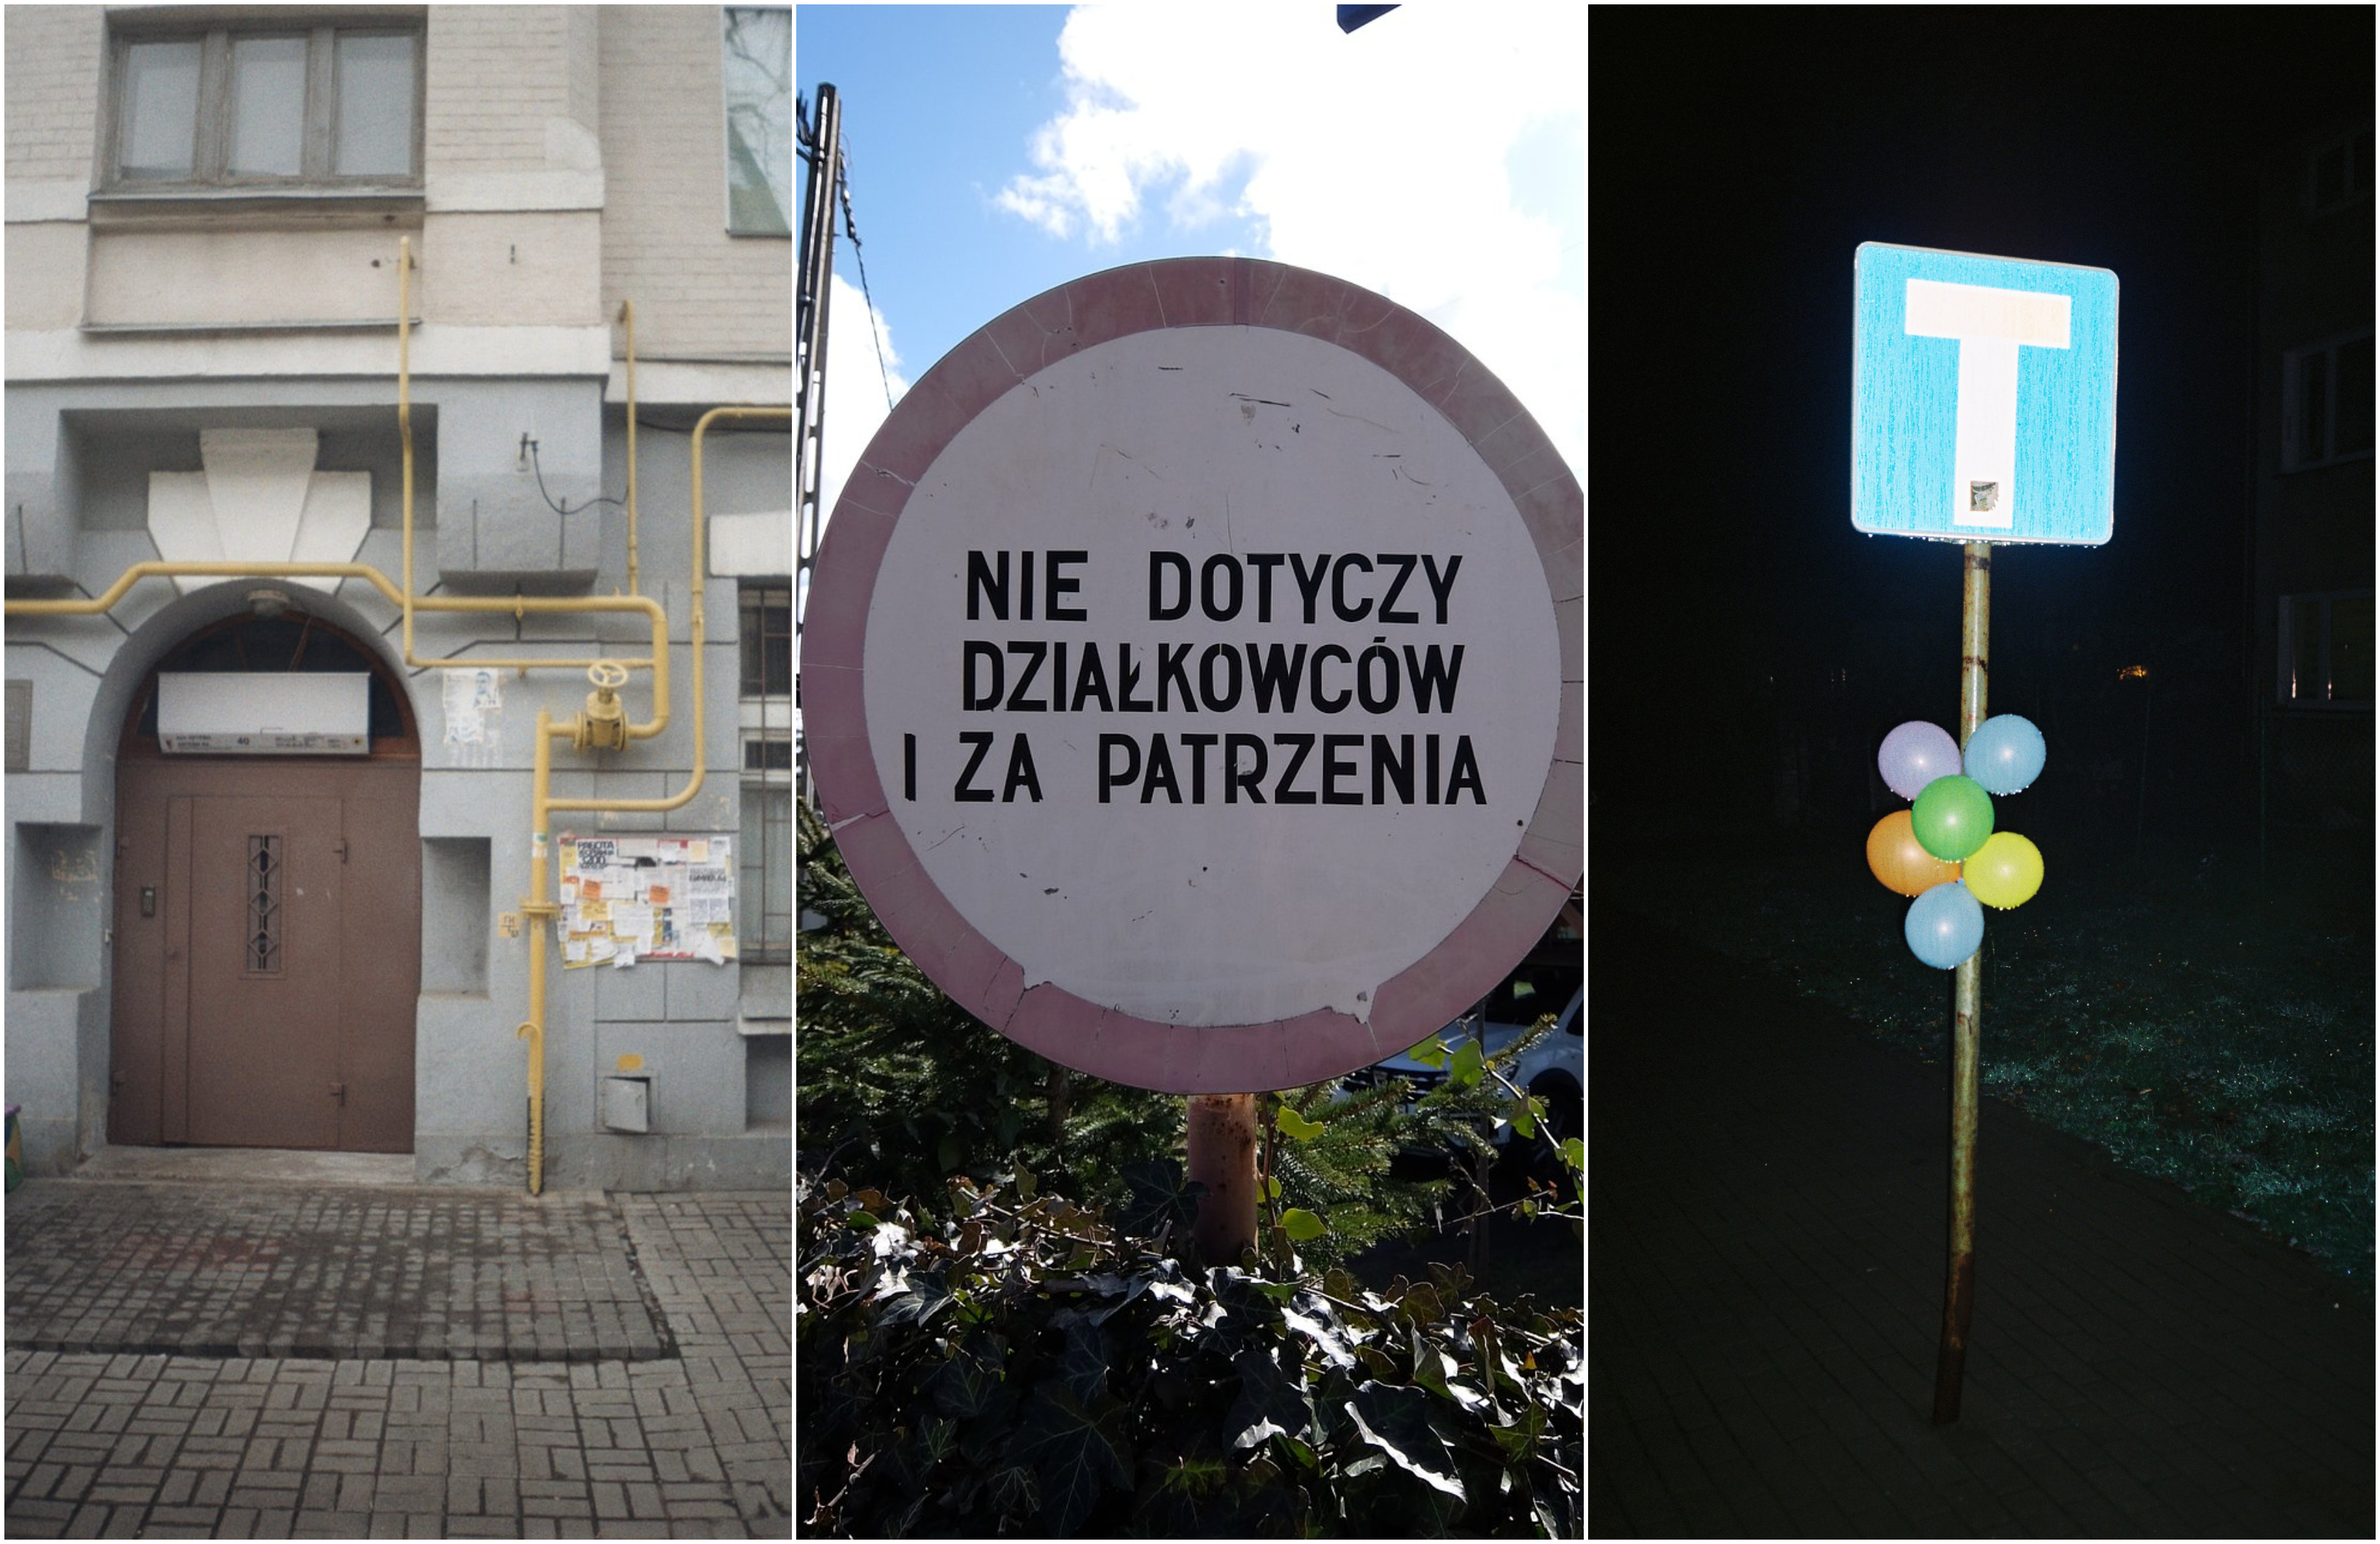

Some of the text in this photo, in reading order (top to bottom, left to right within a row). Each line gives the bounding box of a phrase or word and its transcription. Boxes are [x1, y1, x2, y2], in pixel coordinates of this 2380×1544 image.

[968, 550, 1462, 624] NIE DOTYCZY
[963, 636, 1465, 714] DZIAŁKOWCÓW
[904, 732, 1487, 805] I ZA PATRZENIA
